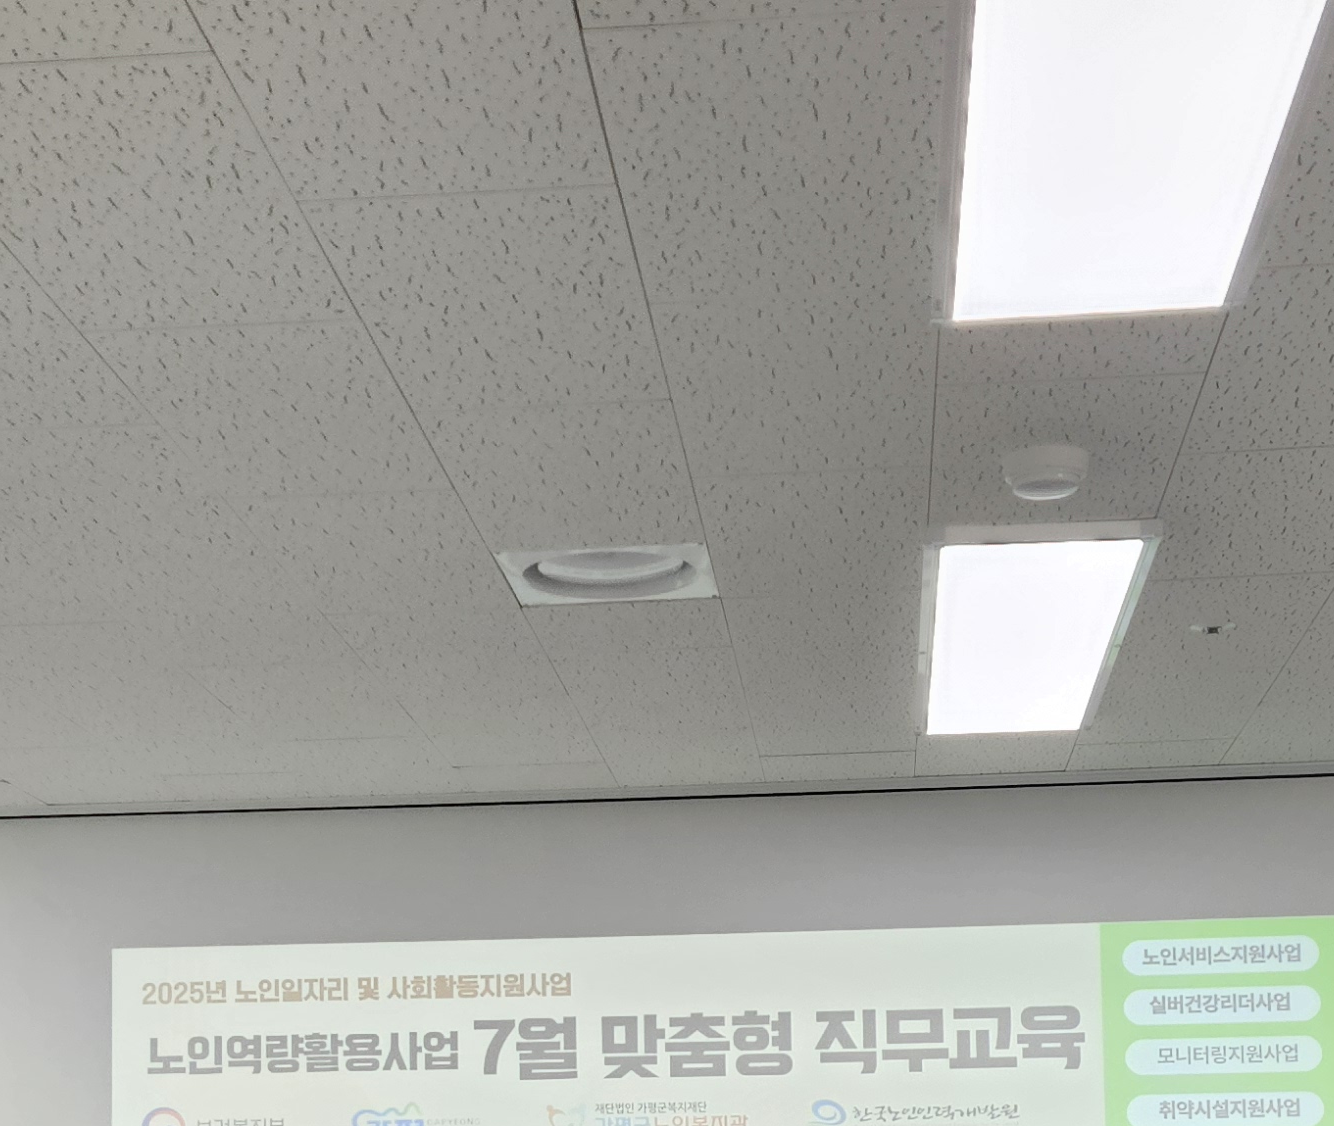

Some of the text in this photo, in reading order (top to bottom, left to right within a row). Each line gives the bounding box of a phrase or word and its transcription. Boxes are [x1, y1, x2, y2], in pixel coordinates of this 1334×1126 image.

[1141, 943, 1302, 966] 노인서비스지원사업
[142, 972, 572, 1005] 2025년 노인일자리 및 사회활동지원사업
[1149, 992, 1291, 1015] 실버건강리더사업
[147, 1005, 1086, 1080] 노인역량활용사업 7월 맞춤형 직무교육
[1157, 1043, 1299, 1065] 모니터링지원사업
[594, 1101, 707, 1114] 재단법인 가평군복지재단
[852, 1104, 1020, 1122] 한국노인인력개발원
[1159, 1098, 1301, 1120] 취약시설지원사업
